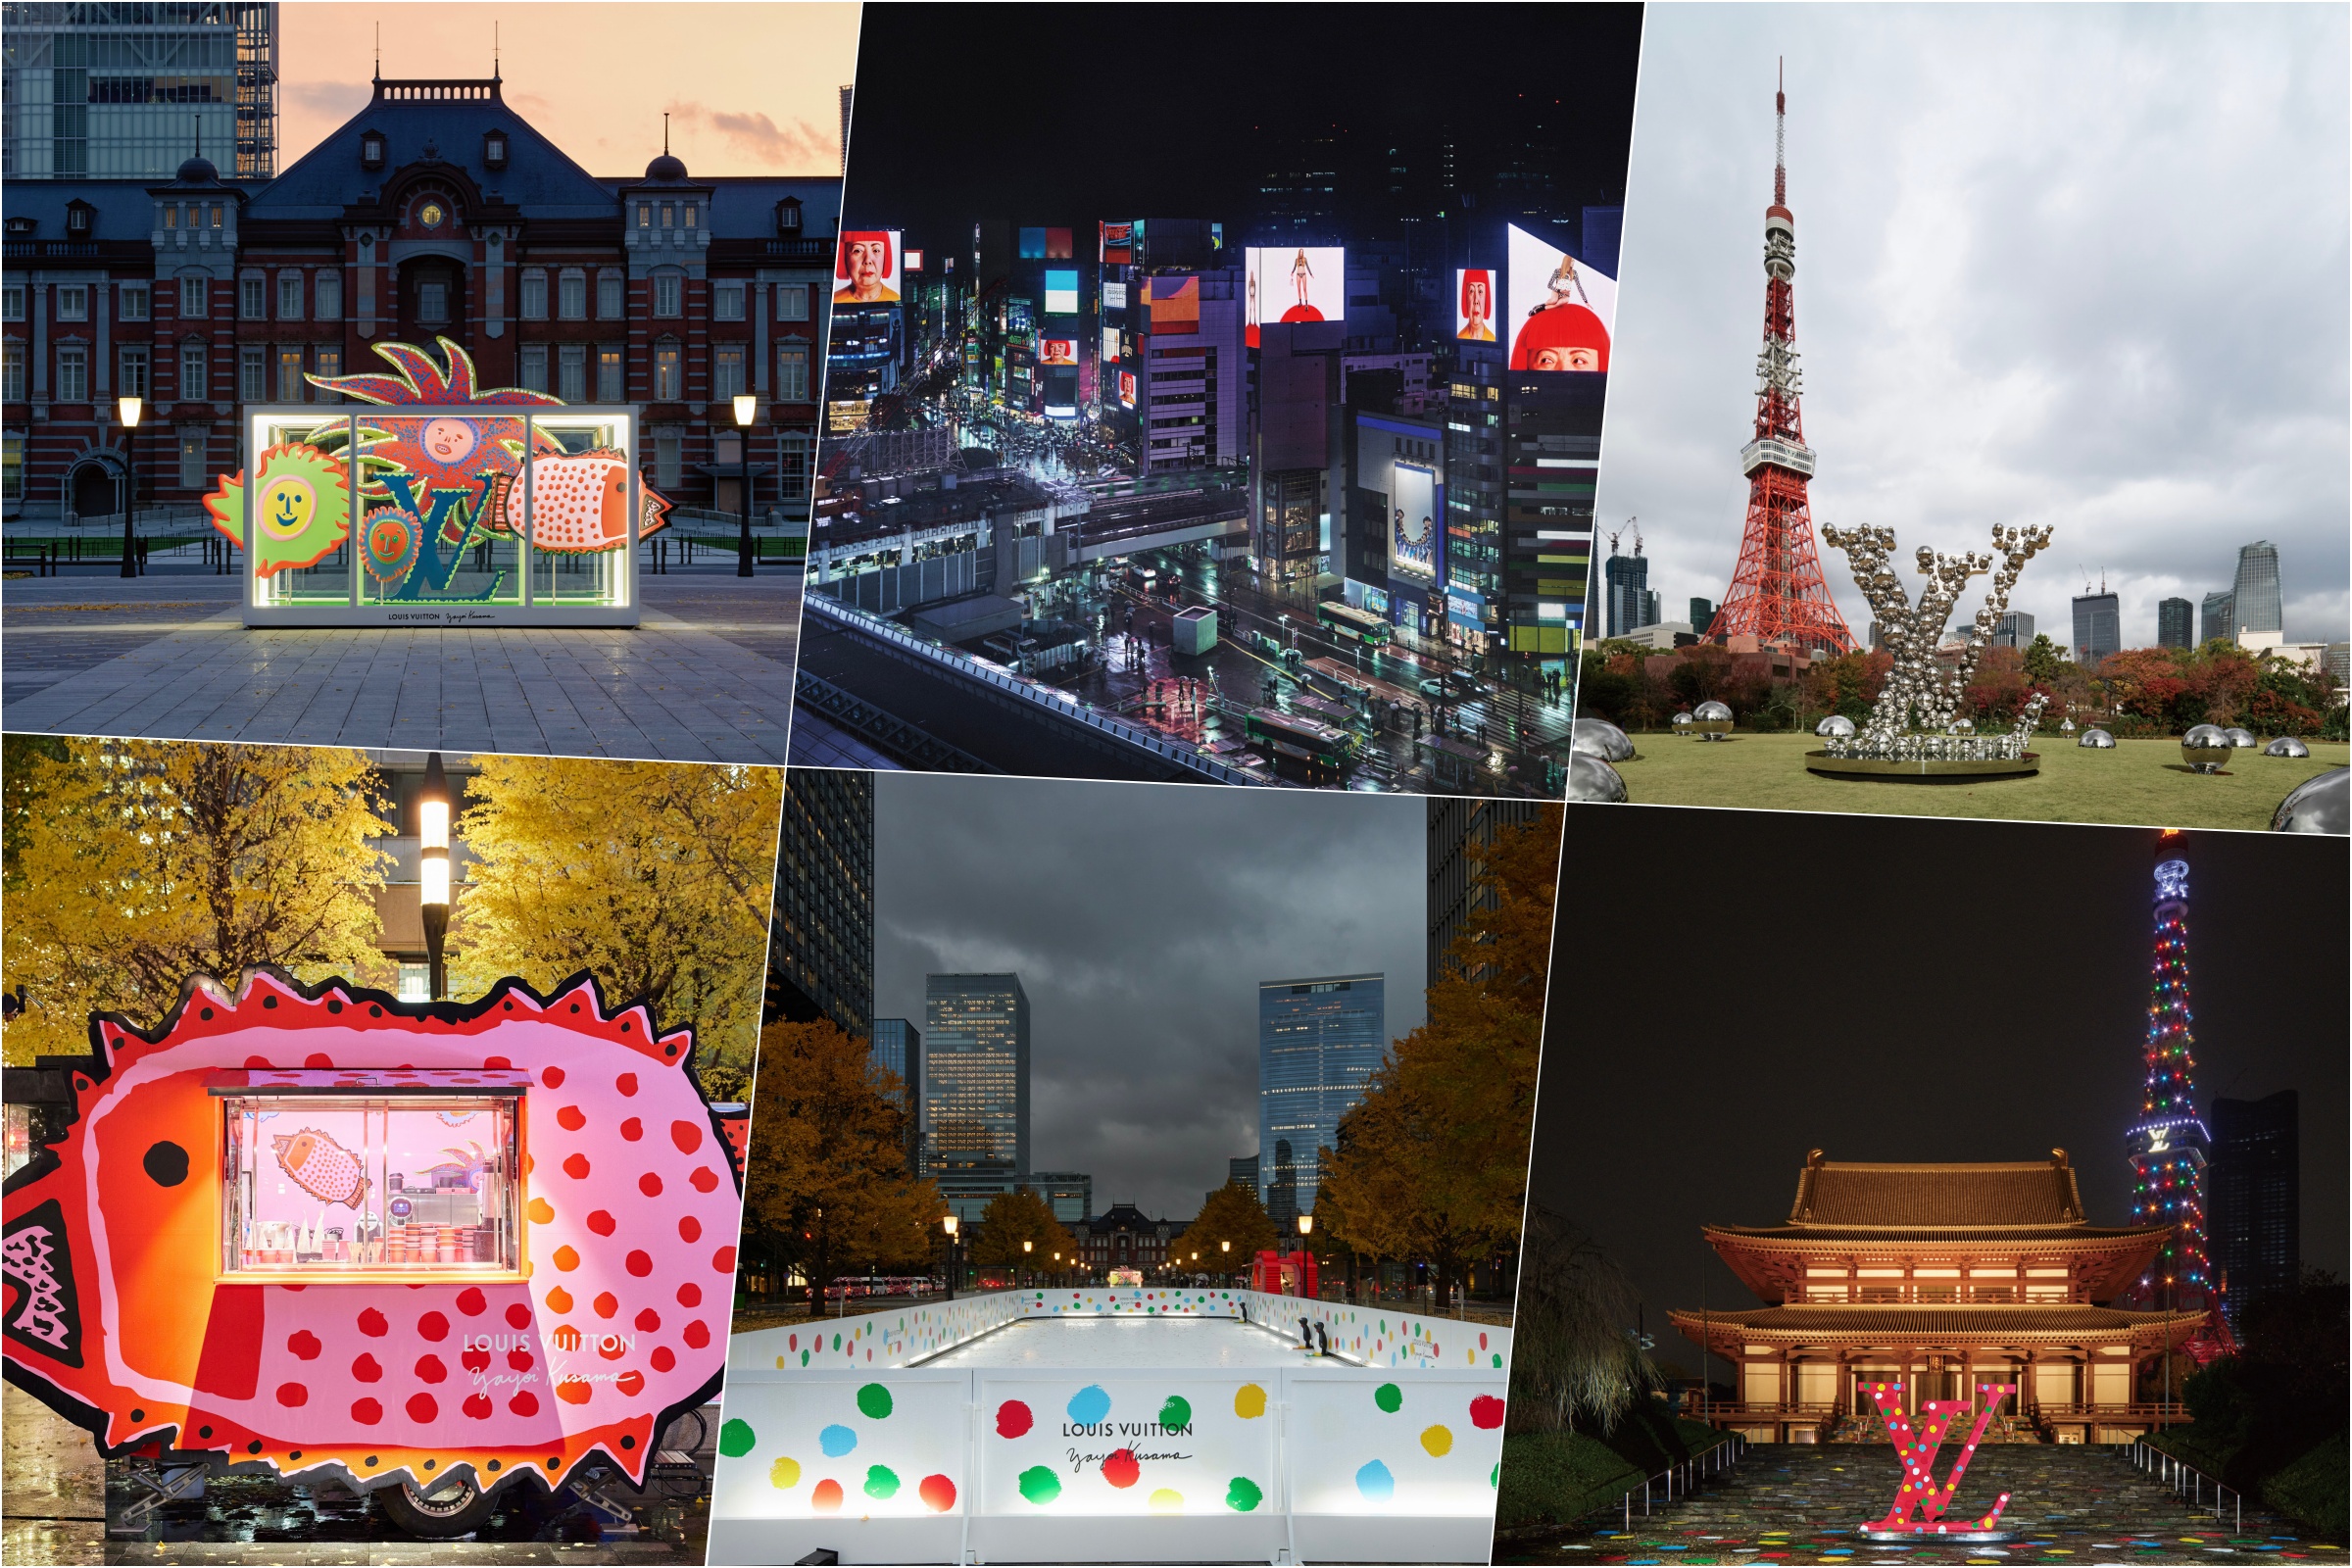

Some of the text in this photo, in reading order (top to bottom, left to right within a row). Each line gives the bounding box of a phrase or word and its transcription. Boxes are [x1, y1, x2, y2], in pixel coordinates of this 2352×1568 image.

[464, 1334, 636, 1352] LOUIS VUITTON
[546, 1356, 636, 1386] Kusama
[1062, 1423, 1193, 1437] LOUIS VUITTON
[1124, 1440, 1193, 1462] Kusama
